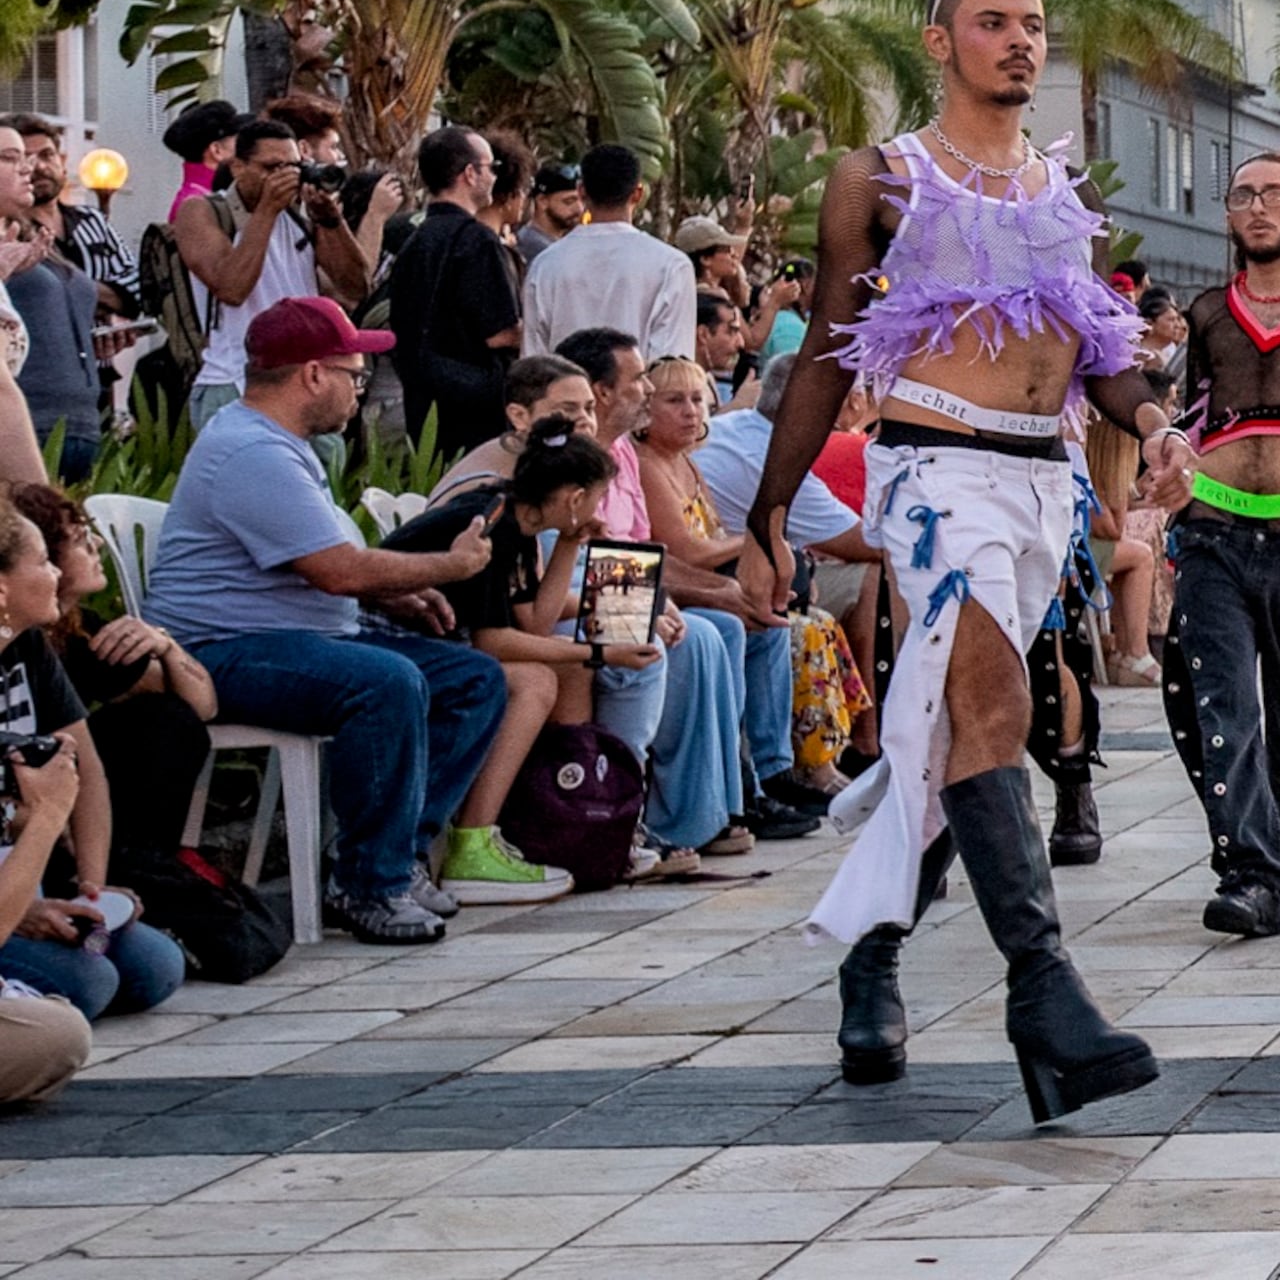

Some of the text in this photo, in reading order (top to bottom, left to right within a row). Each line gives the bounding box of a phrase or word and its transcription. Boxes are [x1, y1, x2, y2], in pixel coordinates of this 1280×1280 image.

[901, 382, 1051, 433] lechat lechat
[1199, 482, 1249, 508] lechat
